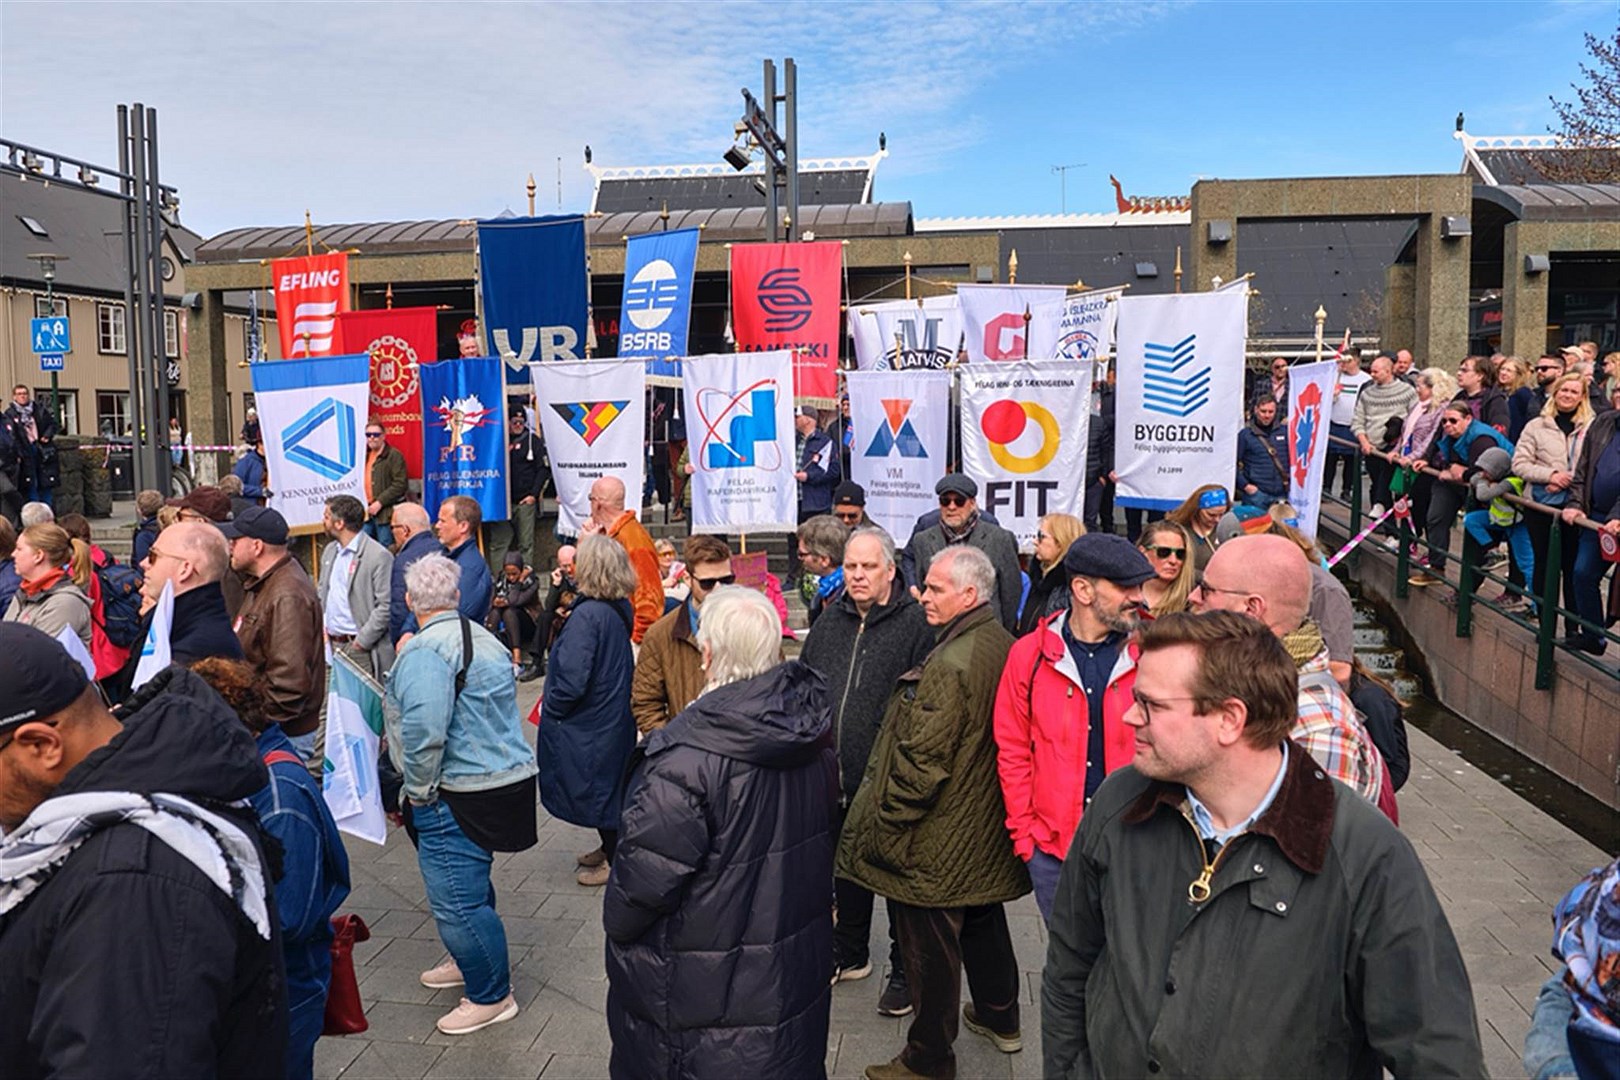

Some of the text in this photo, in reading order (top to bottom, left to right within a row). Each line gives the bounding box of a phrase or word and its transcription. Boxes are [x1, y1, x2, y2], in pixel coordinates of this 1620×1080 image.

[280, 269, 340, 291] EFLING
[492, 325, 579, 372] VR
[621, 333, 672, 351] BSRB
[42, 357, 63, 368] TAXI
[1013, 380, 1023, 388] OG
[1135, 424, 1214, 442] BYGGIÐN
[1134, 443, 1214, 454] Félag byggingamanna
[886, 467, 904, 479] VM
[985, 480, 1059, 518] FIT
